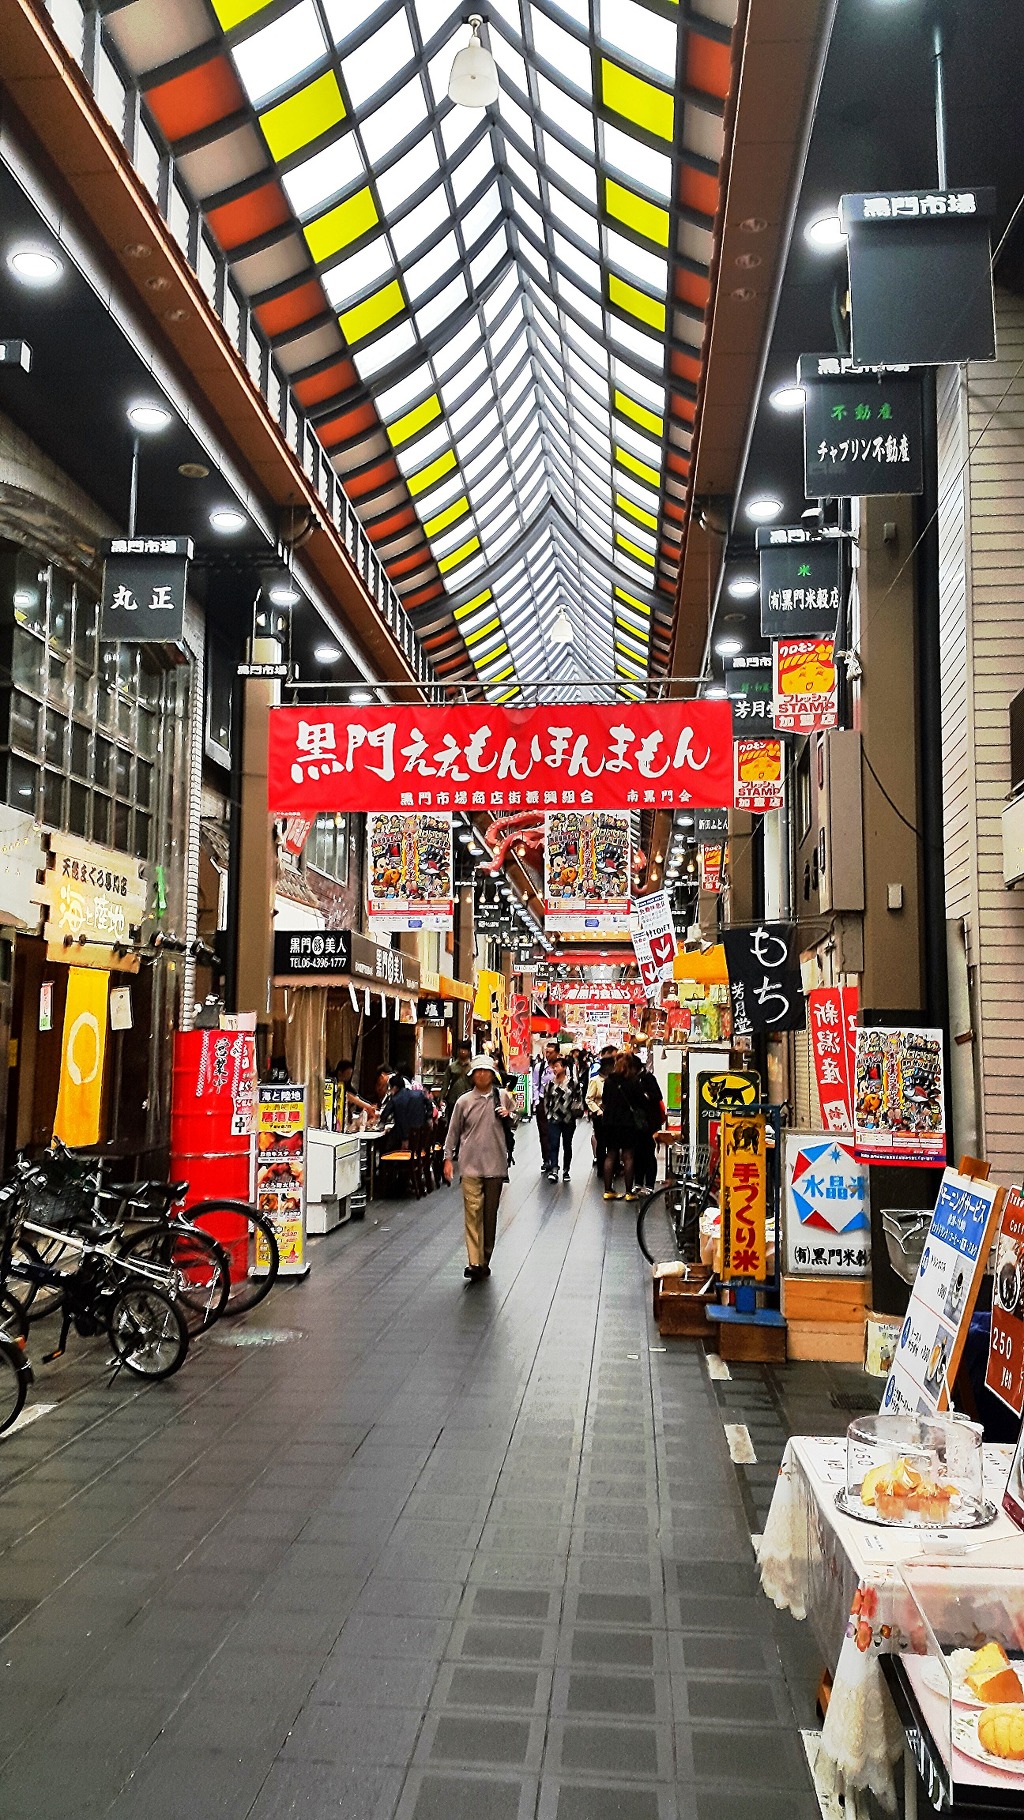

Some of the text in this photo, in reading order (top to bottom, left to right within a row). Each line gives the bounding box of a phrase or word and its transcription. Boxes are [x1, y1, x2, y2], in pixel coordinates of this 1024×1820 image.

[864, 193, 976, 217] 黒門市場
[831, 403, 893, 420] 不動産
[111, 539, 177, 553] 黒門市場
[797, 564, 811, 577] 米
[110, 585, 174, 610] 丸正
[779, 642, 816, 657] クロモン
[778, 702, 835, 714] STAMP
[779, 714, 835, 727] 加盟店
[627, 789, 692, 803] 南黒門会
[738, 788, 780, 796] STAMP
[750, 926, 789, 1024] もち
[731, 981, 754, 1035] 芳月堂
[732, 1162, 760, 1272] 手づくり米
[993, 1326, 1012, 1361] 250
[1001, 1365, 1013, 1391] yen
